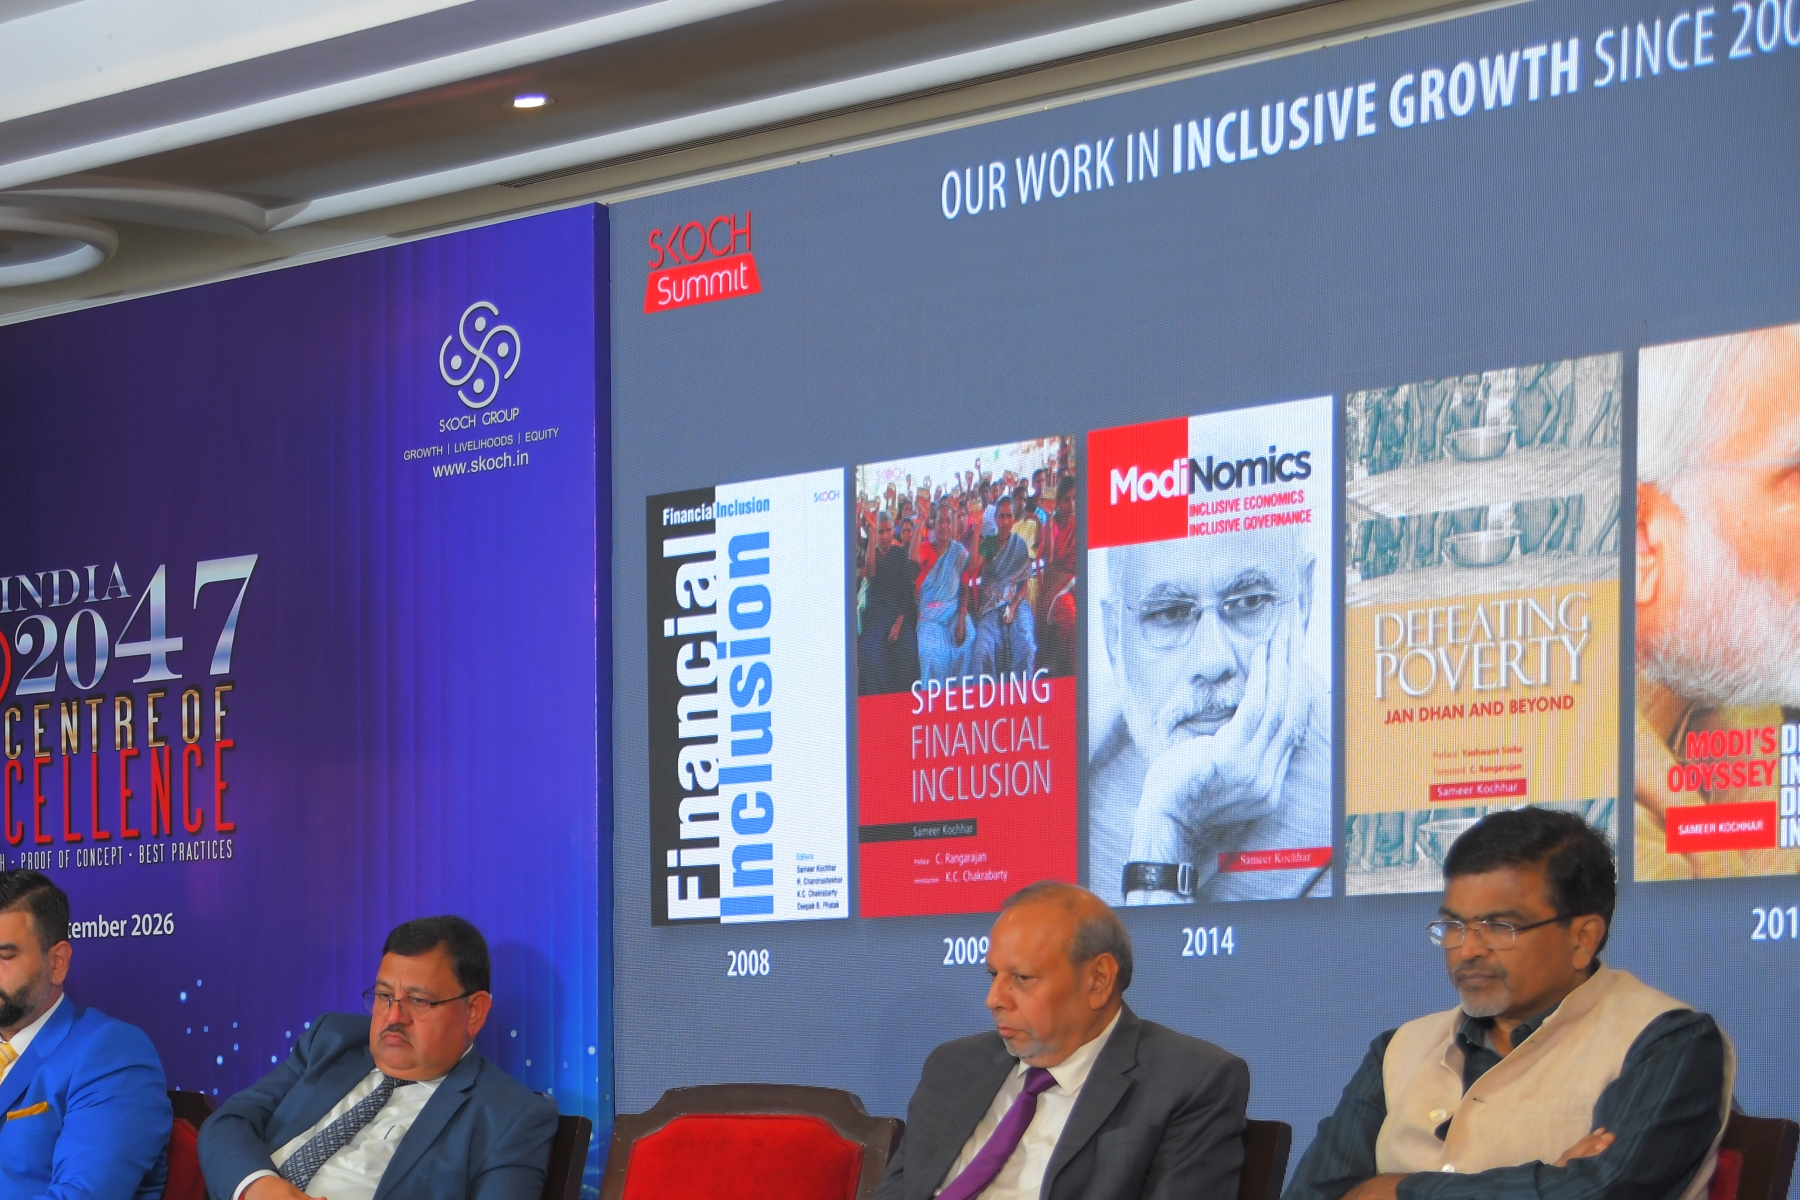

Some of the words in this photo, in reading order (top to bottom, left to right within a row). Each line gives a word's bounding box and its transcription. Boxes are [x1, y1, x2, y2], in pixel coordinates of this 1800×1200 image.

[941, 160, 1006, 220] OUR
[1015, 137, 1115, 205] WORK
[1126, 128, 1160, 184] IN
[1172, 82, 1377, 175] INCLUSIVE
[1388, 36, 1579, 129] GROWTH
[1594, 6, 1715, 88] SINCE
[648, 209, 751, 269] SKOCH
[657, 262, 749, 306] Summit
[438, 413, 476, 433] SKOCH
[481, 407, 520, 426] GROUP
[403, 445, 443, 461] GROWTH
[454, 434, 514, 454] LIVELIHOODS
[525, 427, 560, 443] EQUITY
[432, 449, 529, 479] www.skoch.in
[1188, 498, 1241, 518] INCLUSIVE
[1243, 489, 1305, 511] ECONOMICS
[1188, 517, 1241, 537] INCLUSIVE
[1243, 508, 1312, 531] GOVERNANCE
[14, 553, 259, 696] 2047
[1374, 591, 1590, 652] DEFEATING
[1374, 633, 1589, 699] POVERTY
[911, 668, 1051, 715] SPEEDING
[4, 691, 166, 760] CENTRE
[181, 685, 234, 746] OF
[662, 532, 720, 921] Financial
[717, 531, 774, 917] Inclusion
[1384, 708, 1414, 725] JAN
[1418, 704, 1464, 722] DHAN
[1469, 701, 1505, 718] AND
[1509, 694, 1575, 715] BEYOND
[911, 715, 1050, 760] FINANCIAL
[1686, 726, 1777, 761] MODI'S
[911, 759, 1051, 804] INCLUSION
[1437, 785, 1473, 797] Sameer
[1667, 759, 1778, 793] ODYSSEY
[913, 825, 940, 838] Sameer
[942, 823, 973, 836] Kochhar
[20, 850, 53, 872] PROOF
[58, 849, 71, 869] OF
[76, 846, 124, 868] CONCEPT
[139, 843, 165, 864] BEST
[171, 839, 233, 862] PRACTICES
[67, 913, 128, 939] tember
[131, 912, 175, 937] 2026
[1181, 926, 1235, 957] 2014
[727, 949, 771, 977] 2008
[942, 936, 990, 966] 2009
